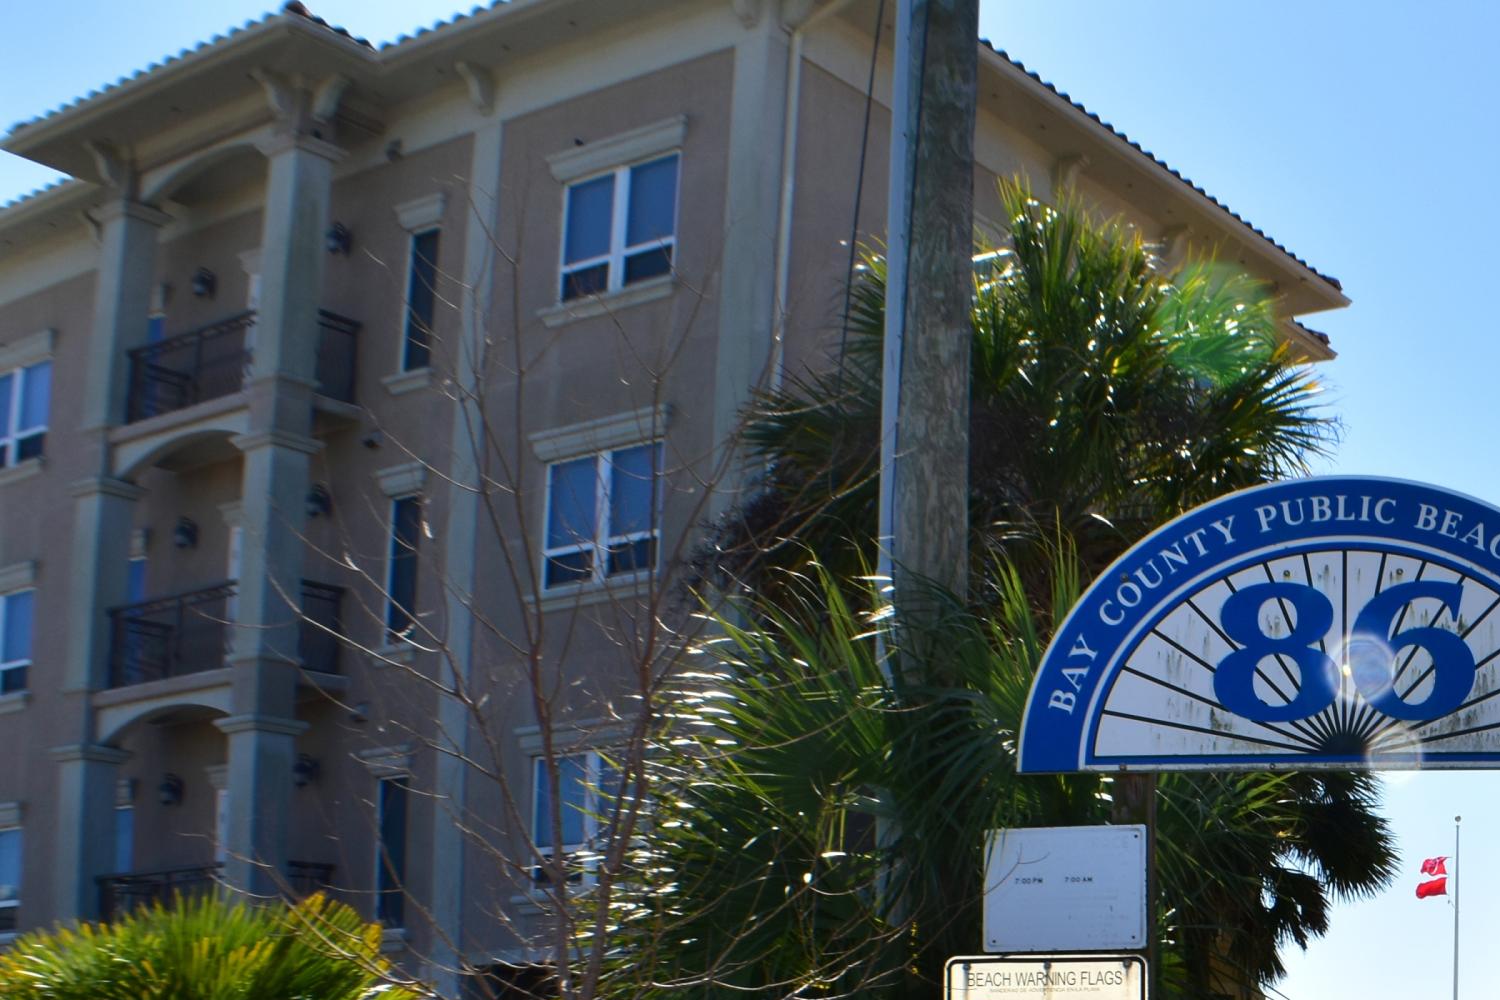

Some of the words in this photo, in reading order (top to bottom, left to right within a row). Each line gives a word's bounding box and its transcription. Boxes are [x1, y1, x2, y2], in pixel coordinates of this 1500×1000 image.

[1048, 633, 1098, 715] BAY
[1099, 515, 1236, 626] COUNTY
[1254, 495, 1397, 533] PUBLIC
[1213, 580, 1476, 723] 86
[968, 972, 1012, 987] BEACH
[1015, 971, 1077, 987] WARNING
[1080, 970, 1123, 986] FLAGS
